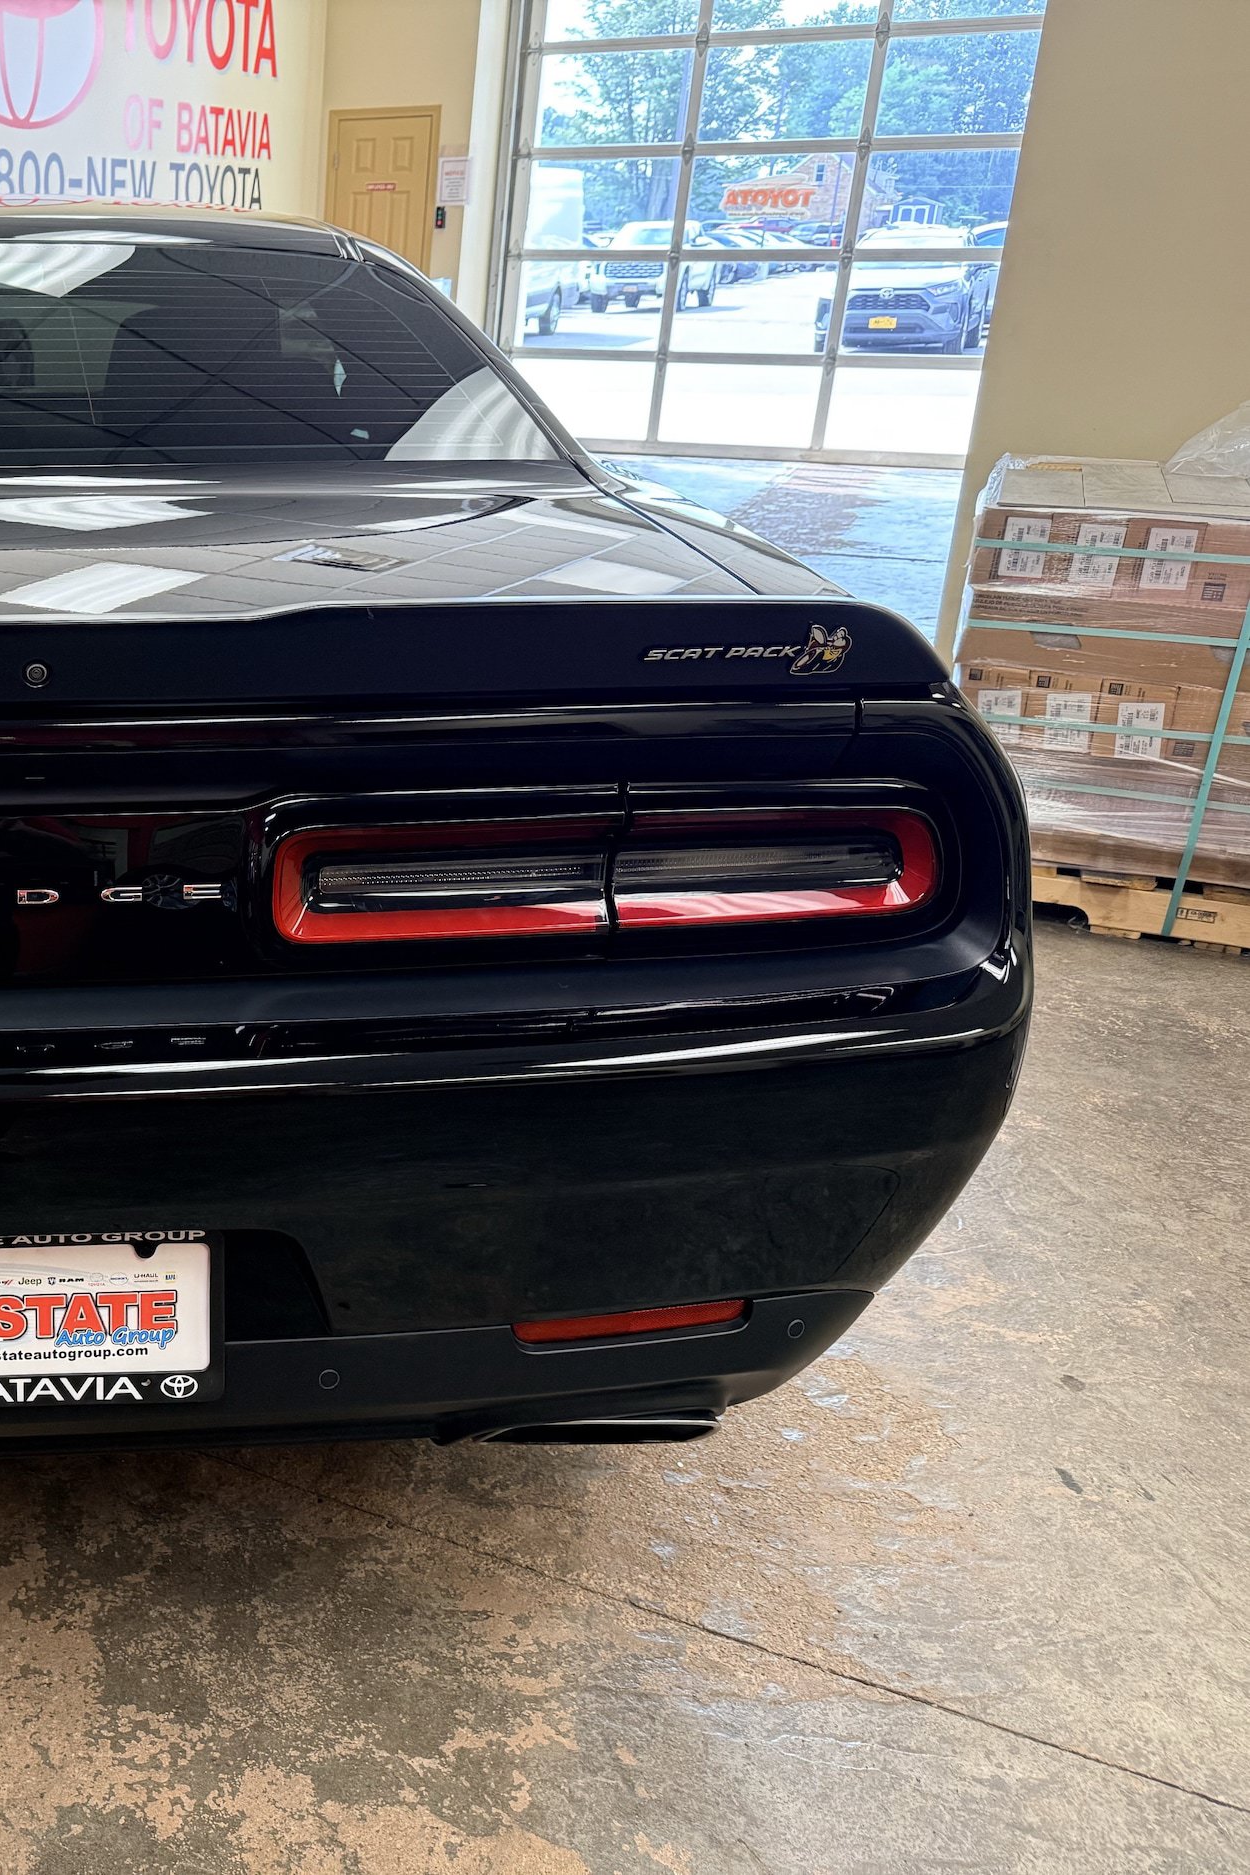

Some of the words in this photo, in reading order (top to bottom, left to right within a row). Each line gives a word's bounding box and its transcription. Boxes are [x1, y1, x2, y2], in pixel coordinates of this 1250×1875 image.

[125, 0, 278, 78] TOYOTA
[124, 94, 164, 151] OF
[176, 101, 272, 160] BATAVIA
[170, 162, 262, 210] TOYOTA
[644, 647, 724, 661] SCAT
[725, 645, 802, 659] PACK
[11, 1233, 92, 1245] AUTO
[101, 1230, 206, 1242] GROUP
[18, 1277, 42, 1286] Jeep
[54, 1330, 105, 1348] Auto
[111, 1326, 177, 1350] Group
